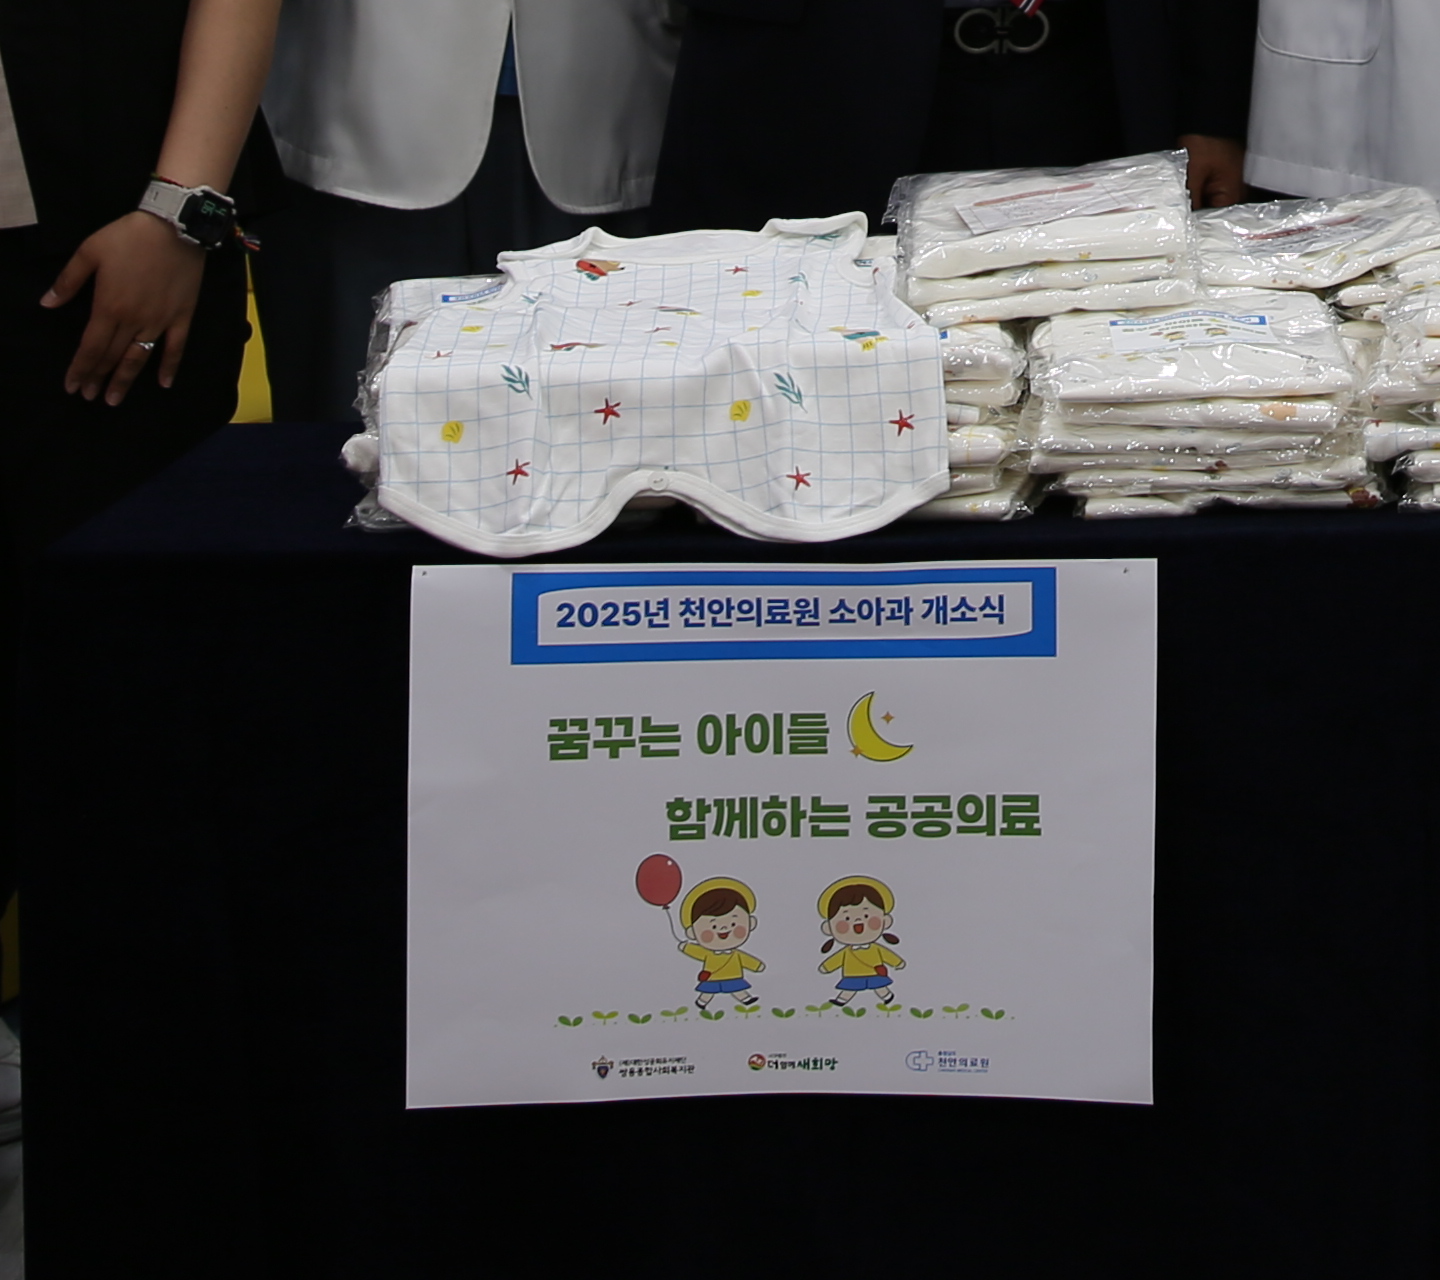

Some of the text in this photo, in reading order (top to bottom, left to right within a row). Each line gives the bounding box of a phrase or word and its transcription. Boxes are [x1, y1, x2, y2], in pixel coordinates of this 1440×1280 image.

[555, 594, 1005, 629] 2025년 천안의료원 소아과 개소식
[547, 712, 830, 761] 꿈꾸는 아이들
[665, 794, 1042, 841] 함께하는 공공의료
[937, 1057, 990, 1068] 천안의료원
